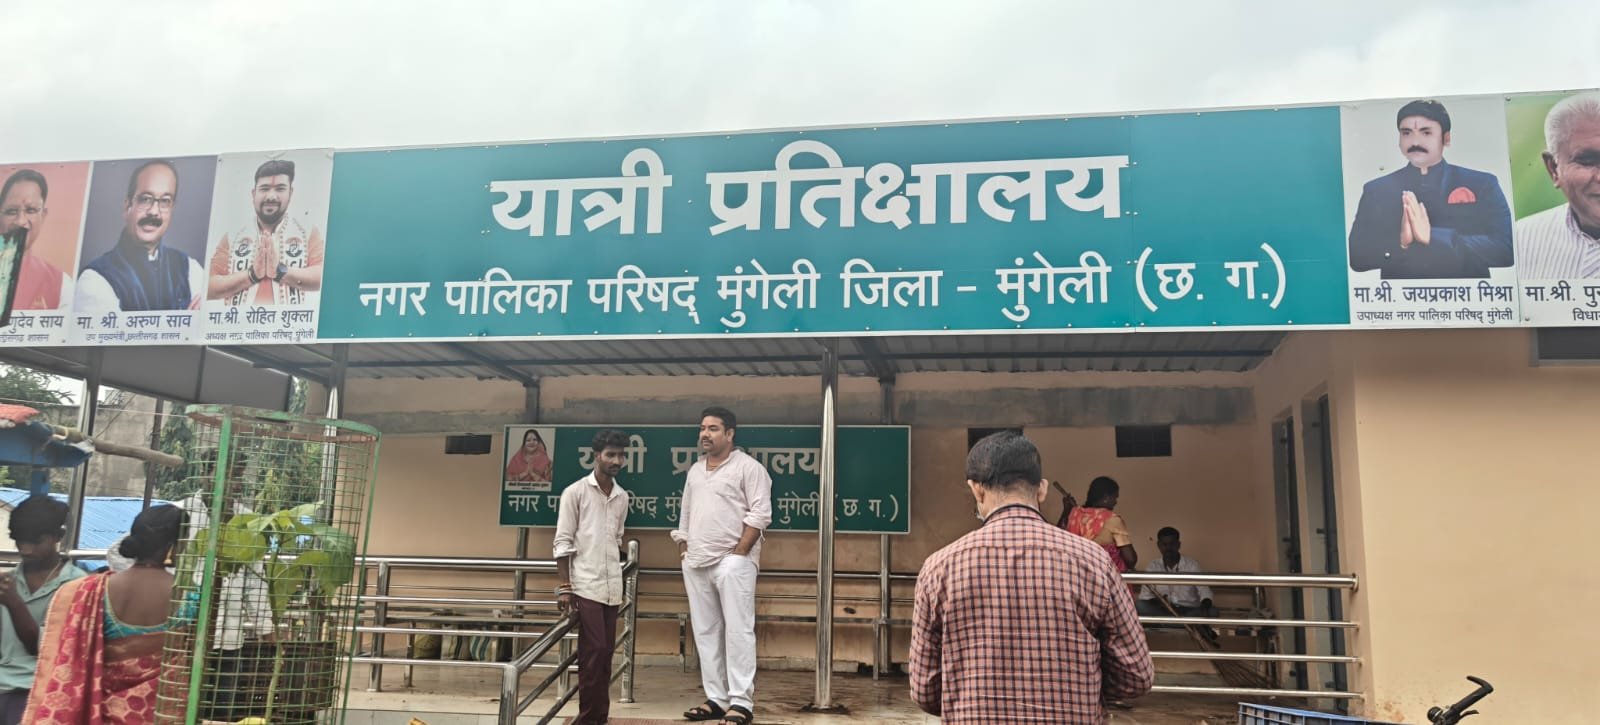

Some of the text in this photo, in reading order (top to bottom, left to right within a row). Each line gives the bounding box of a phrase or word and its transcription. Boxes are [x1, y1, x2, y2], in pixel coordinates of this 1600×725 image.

[491, 140, 1129, 236] यात्री प्रतिक्षालय
[359, 281, 431, 316] नगर
[445, 267, 573, 315] पालिका
[587, 264, 700, 324] परिषद्
[716, 258, 821, 328] मुंगेली
[840, 258, 943, 308] जिला
[995, 250, 1112, 322] मुंगेली
[1402, 286, 1471, 303] जयप्रकाश
[1477, 280, 1513, 303] मिश्रा
[1583, 286, 1600, 307] पु
[9, 312, 64, 334] णुदेव साय
[126, 315, 161, 328] अरुण
[166, 314, 192, 327] साव
[246, 306, 276, 324] रोहित
[281, 309, 314, 328] शुक्ला
[1357, 307, 1513, 324] उपाध्यक्ष नगर पालिका परिषद् मुंगेली
[1573, 307, 1600, 321] विधा
[245, 329, 270, 340] पालिका
[508, 494, 540, 513] नगर
[627, 489, 658, 518] रिषद्
